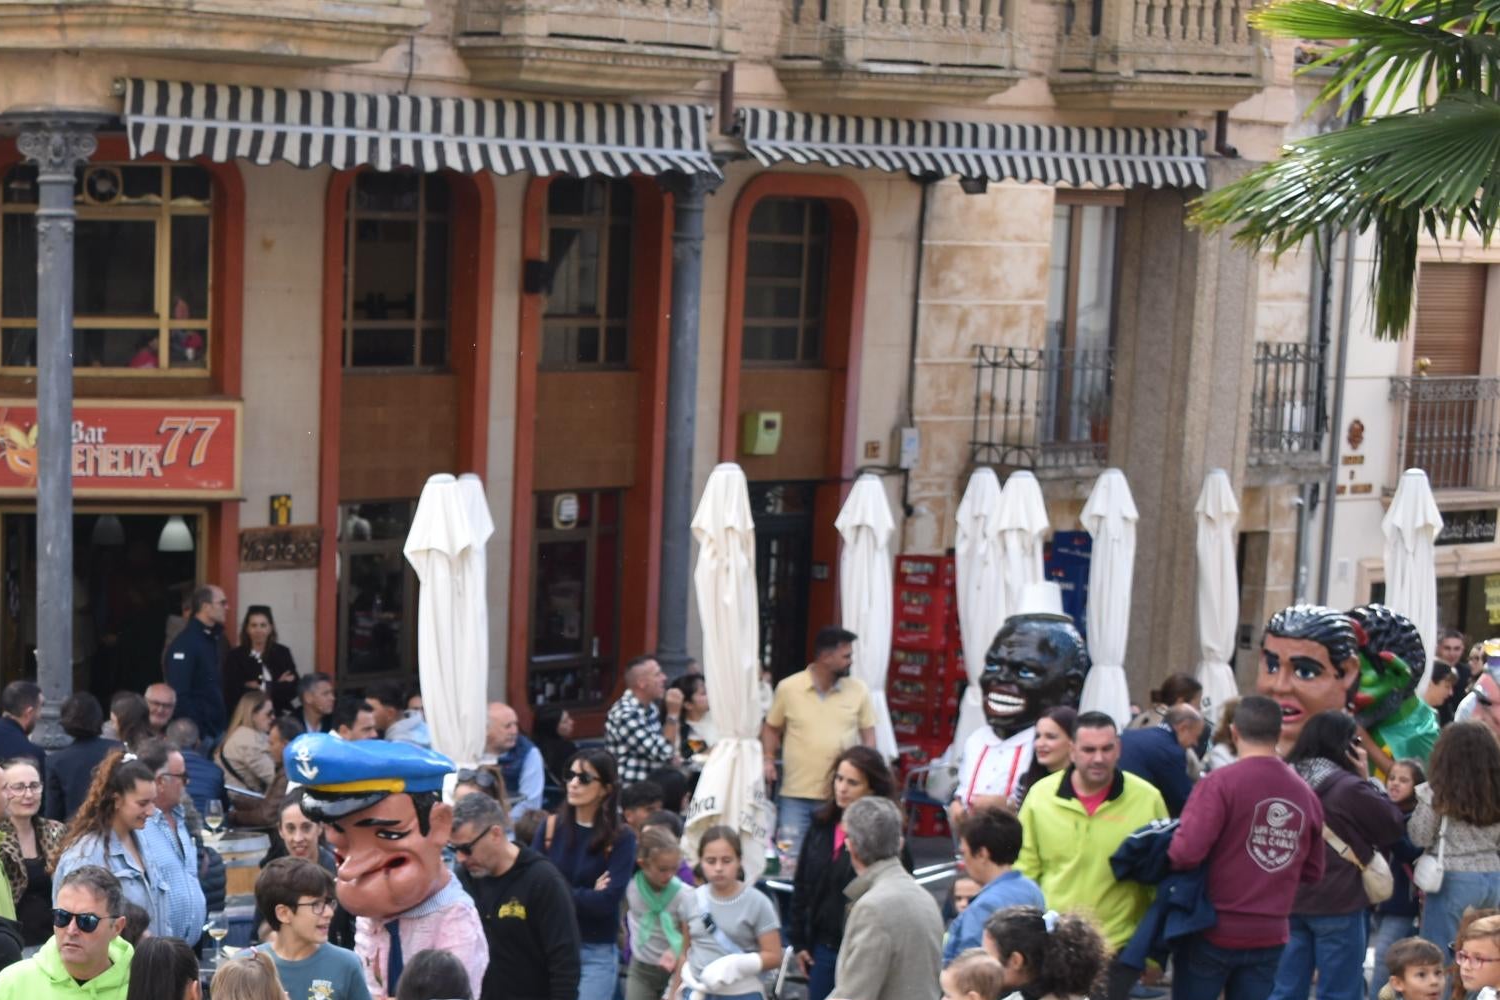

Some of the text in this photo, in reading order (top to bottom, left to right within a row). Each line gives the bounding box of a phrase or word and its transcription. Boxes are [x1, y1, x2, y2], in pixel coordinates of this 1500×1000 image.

[71, 420, 107, 443] Bar
[71, 416, 221, 477] ENECIA 77
